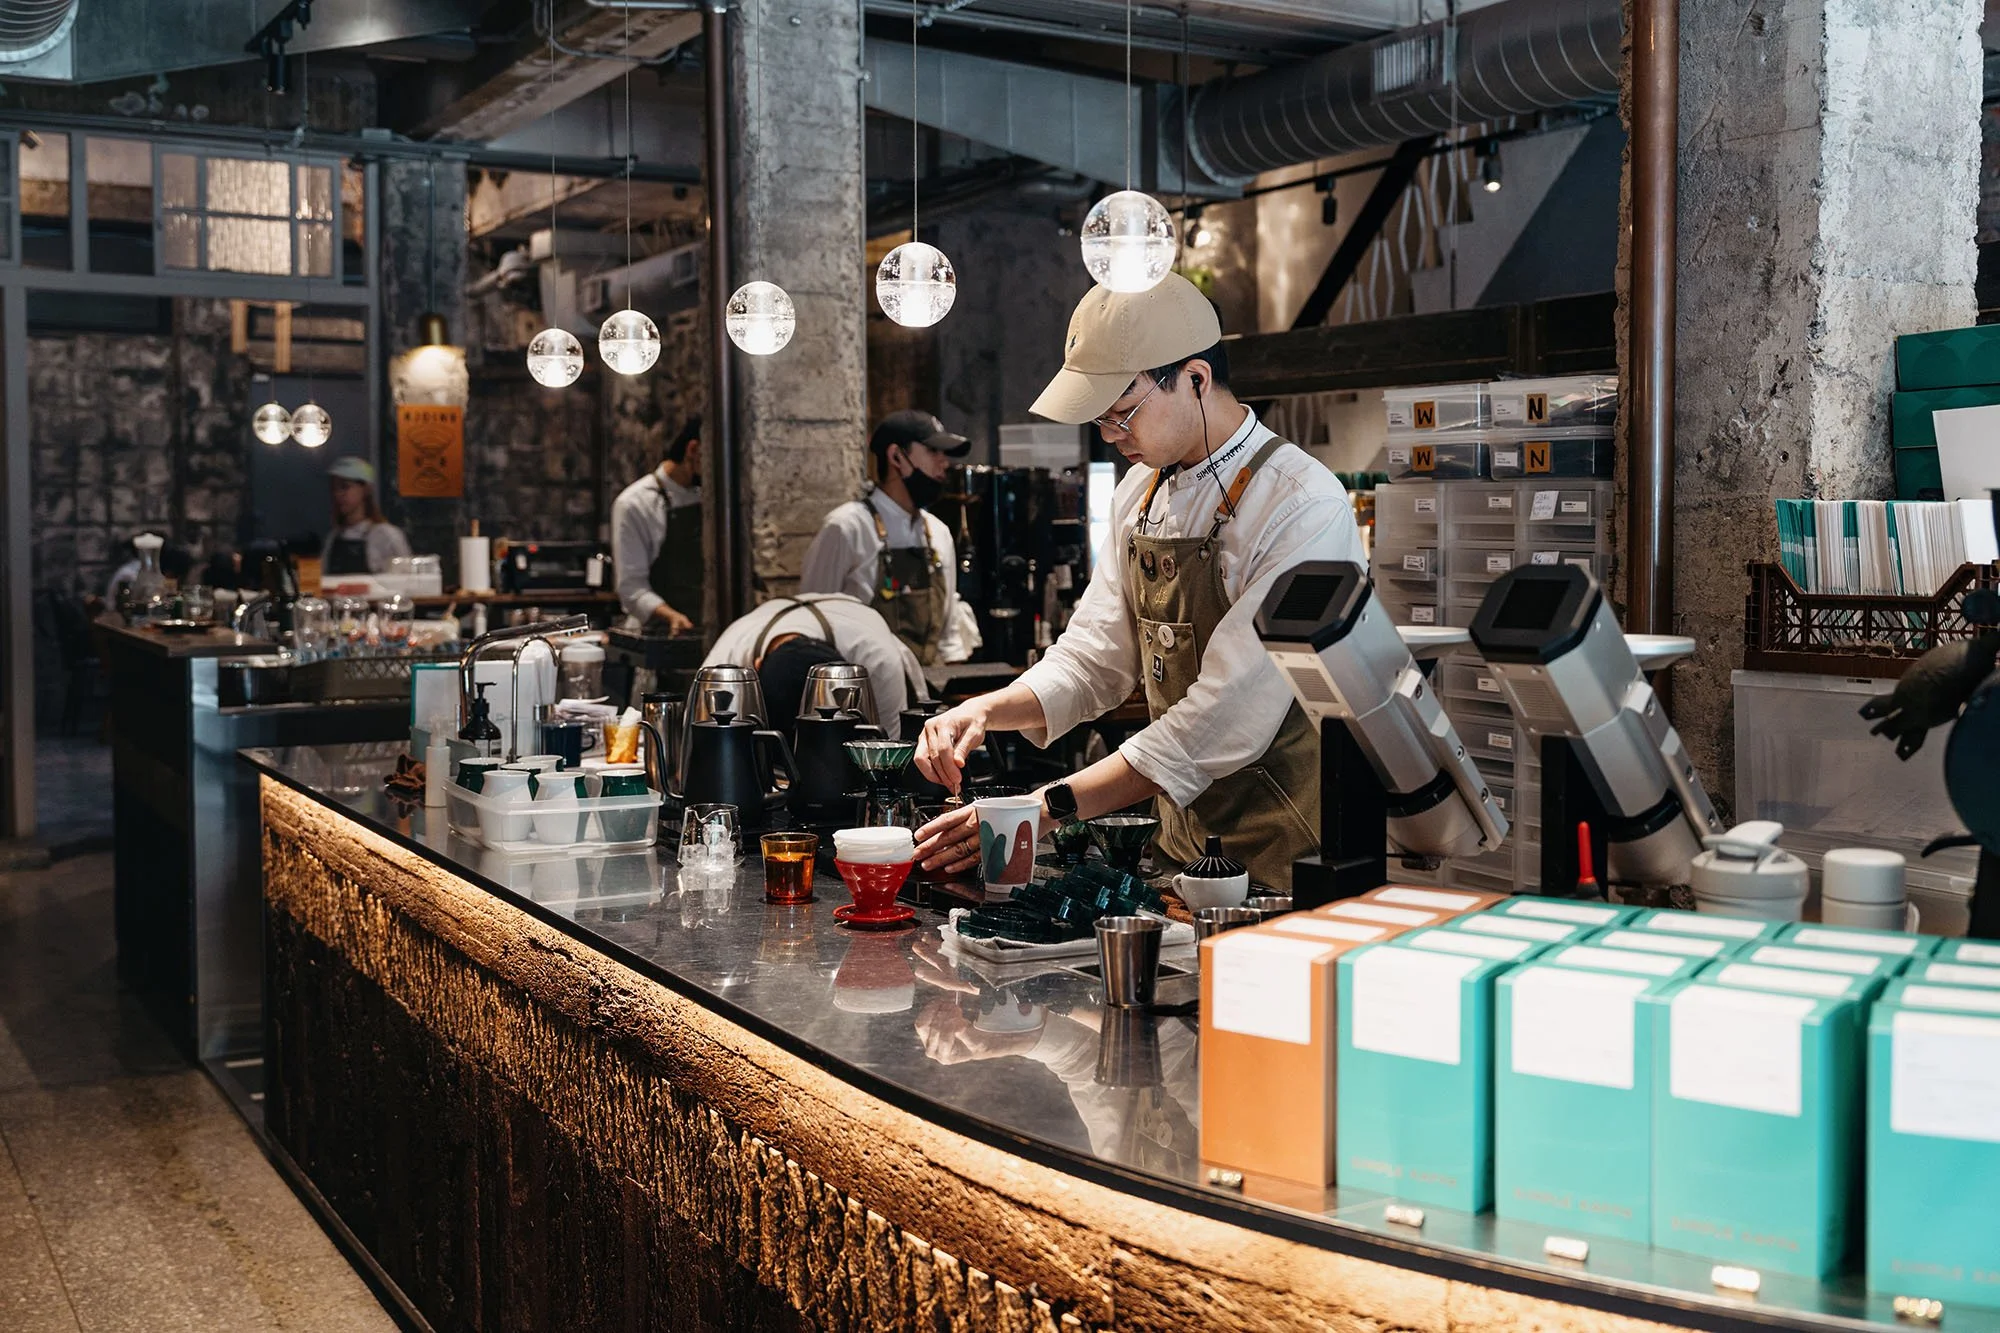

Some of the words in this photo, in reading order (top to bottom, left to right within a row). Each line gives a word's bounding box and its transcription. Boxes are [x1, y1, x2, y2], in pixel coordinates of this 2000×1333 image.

[1417, 407, 1433, 425] W
[1528, 397, 1544, 421] N
[1417, 450, 1431, 467] W
[1530, 449, 1545, 468] N
